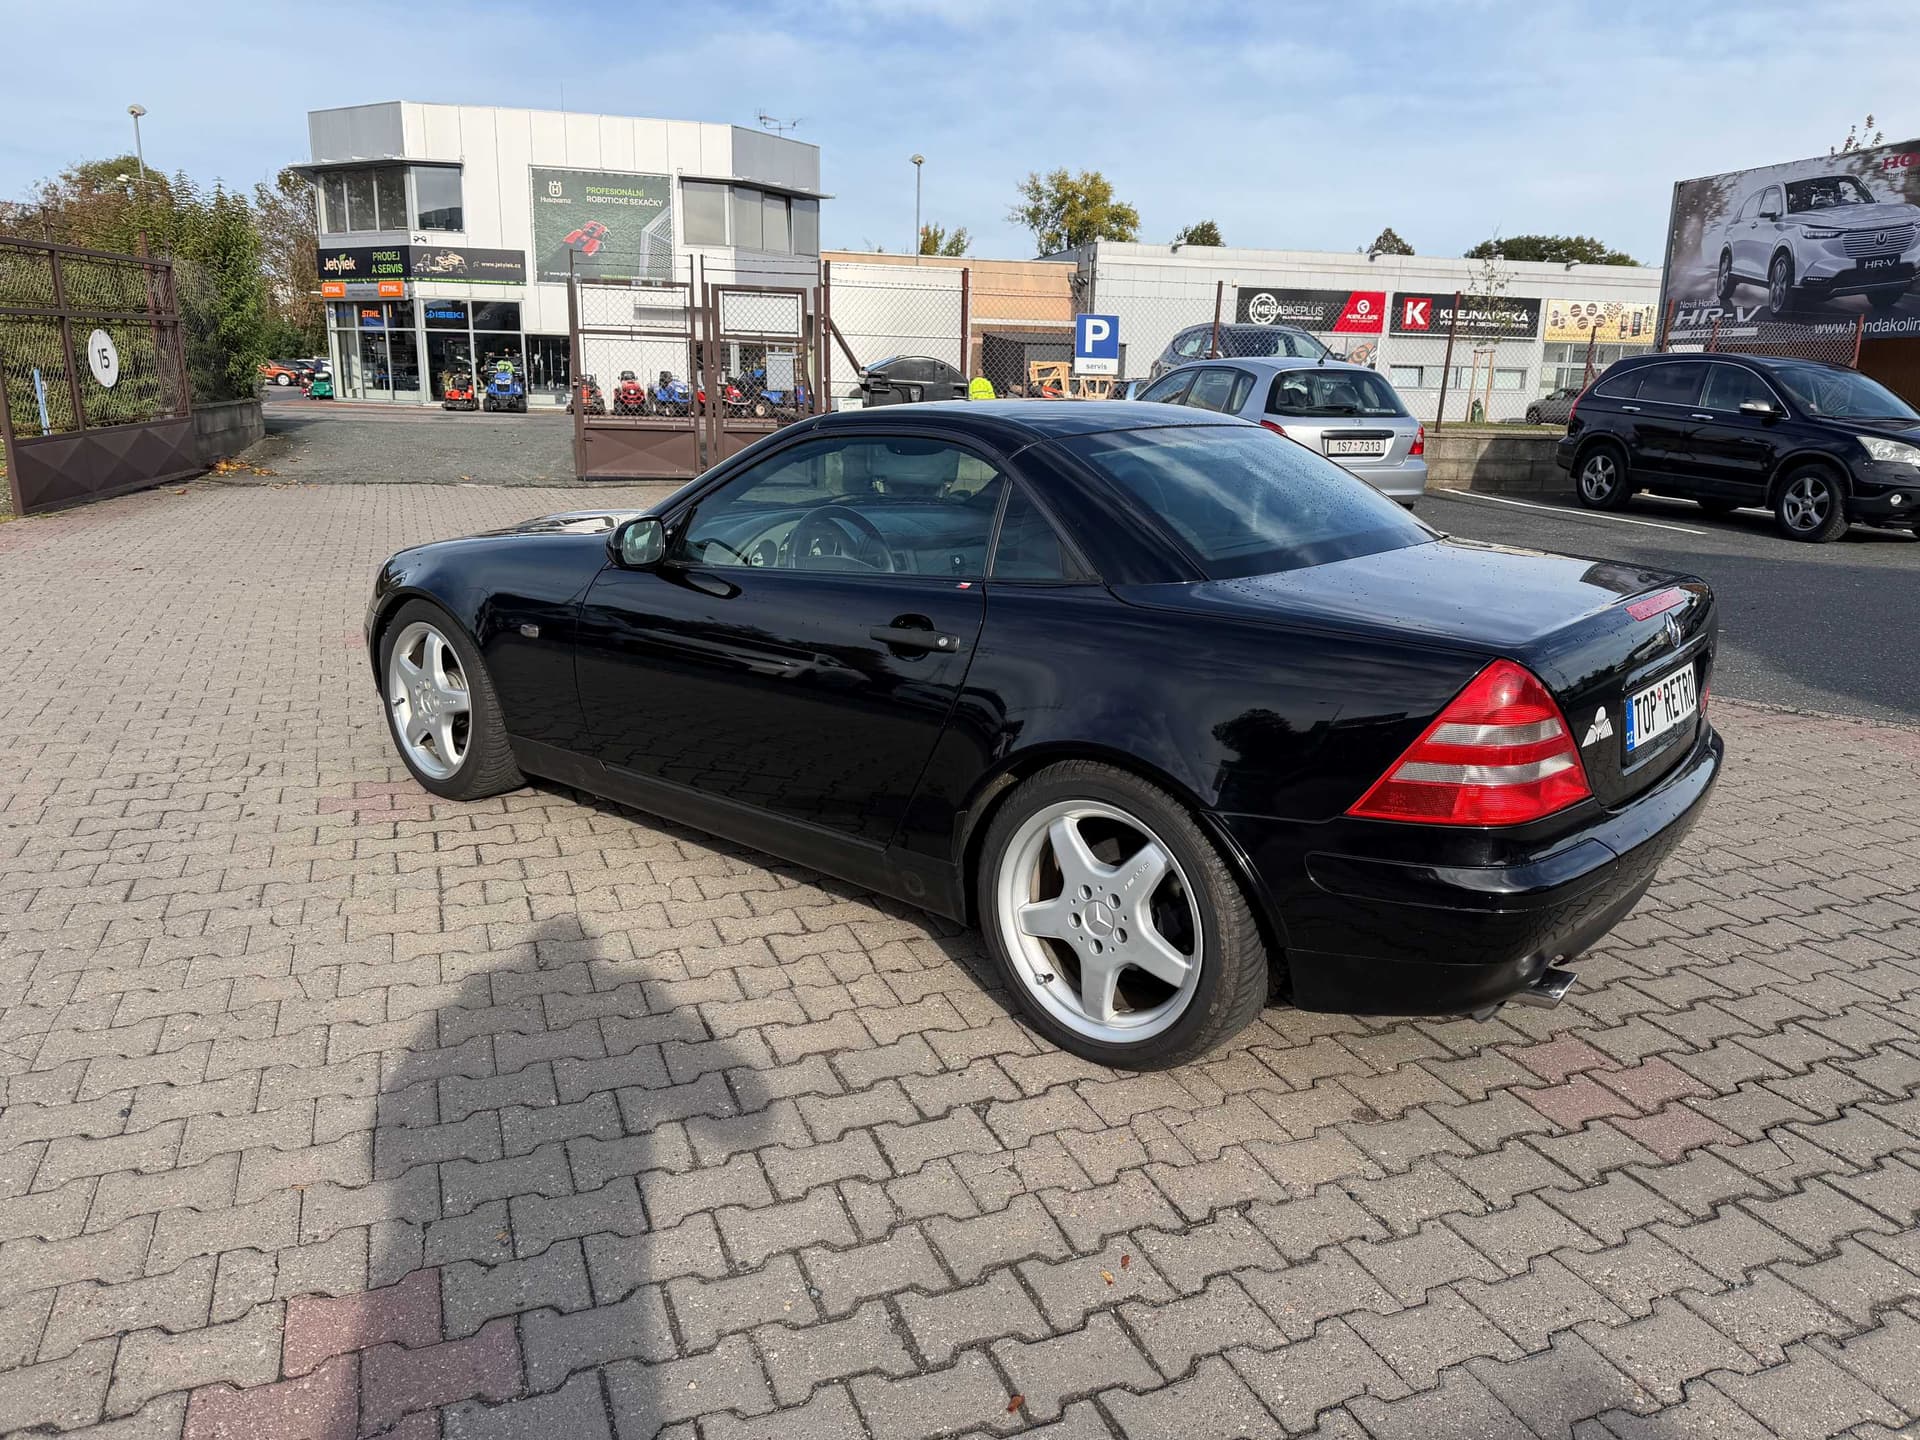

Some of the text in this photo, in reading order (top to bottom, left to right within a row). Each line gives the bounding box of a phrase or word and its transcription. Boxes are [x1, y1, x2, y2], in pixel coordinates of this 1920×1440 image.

[585, 186, 644, 196] PROFESIONÁLNÍ
[586, 195, 663, 207] ROBOTICKÉ SEKAČKY
[372, 251, 400, 261] PRODEJ
[371, 264, 403, 274] A SERVIS
[1864, 259, 1895, 269] HR-V
[380, 284, 399, 292] STIHL
[361, 310, 380, 318] STIHL
[1256, 304, 1324, 316] MEGABIKEPLUS
[1405, 302, 1427, 325] K
[1675, 305, 1762, 326] HR-V
[1815, 317, 1920, 333] www.hndakolin
[1085, 319, 1110, 352] P
[98, 348, 110, 369] 15
[1336, 441, 1381, 451] 1S7 7313
[1634, 669, 1695, 739] TOP RETRO
